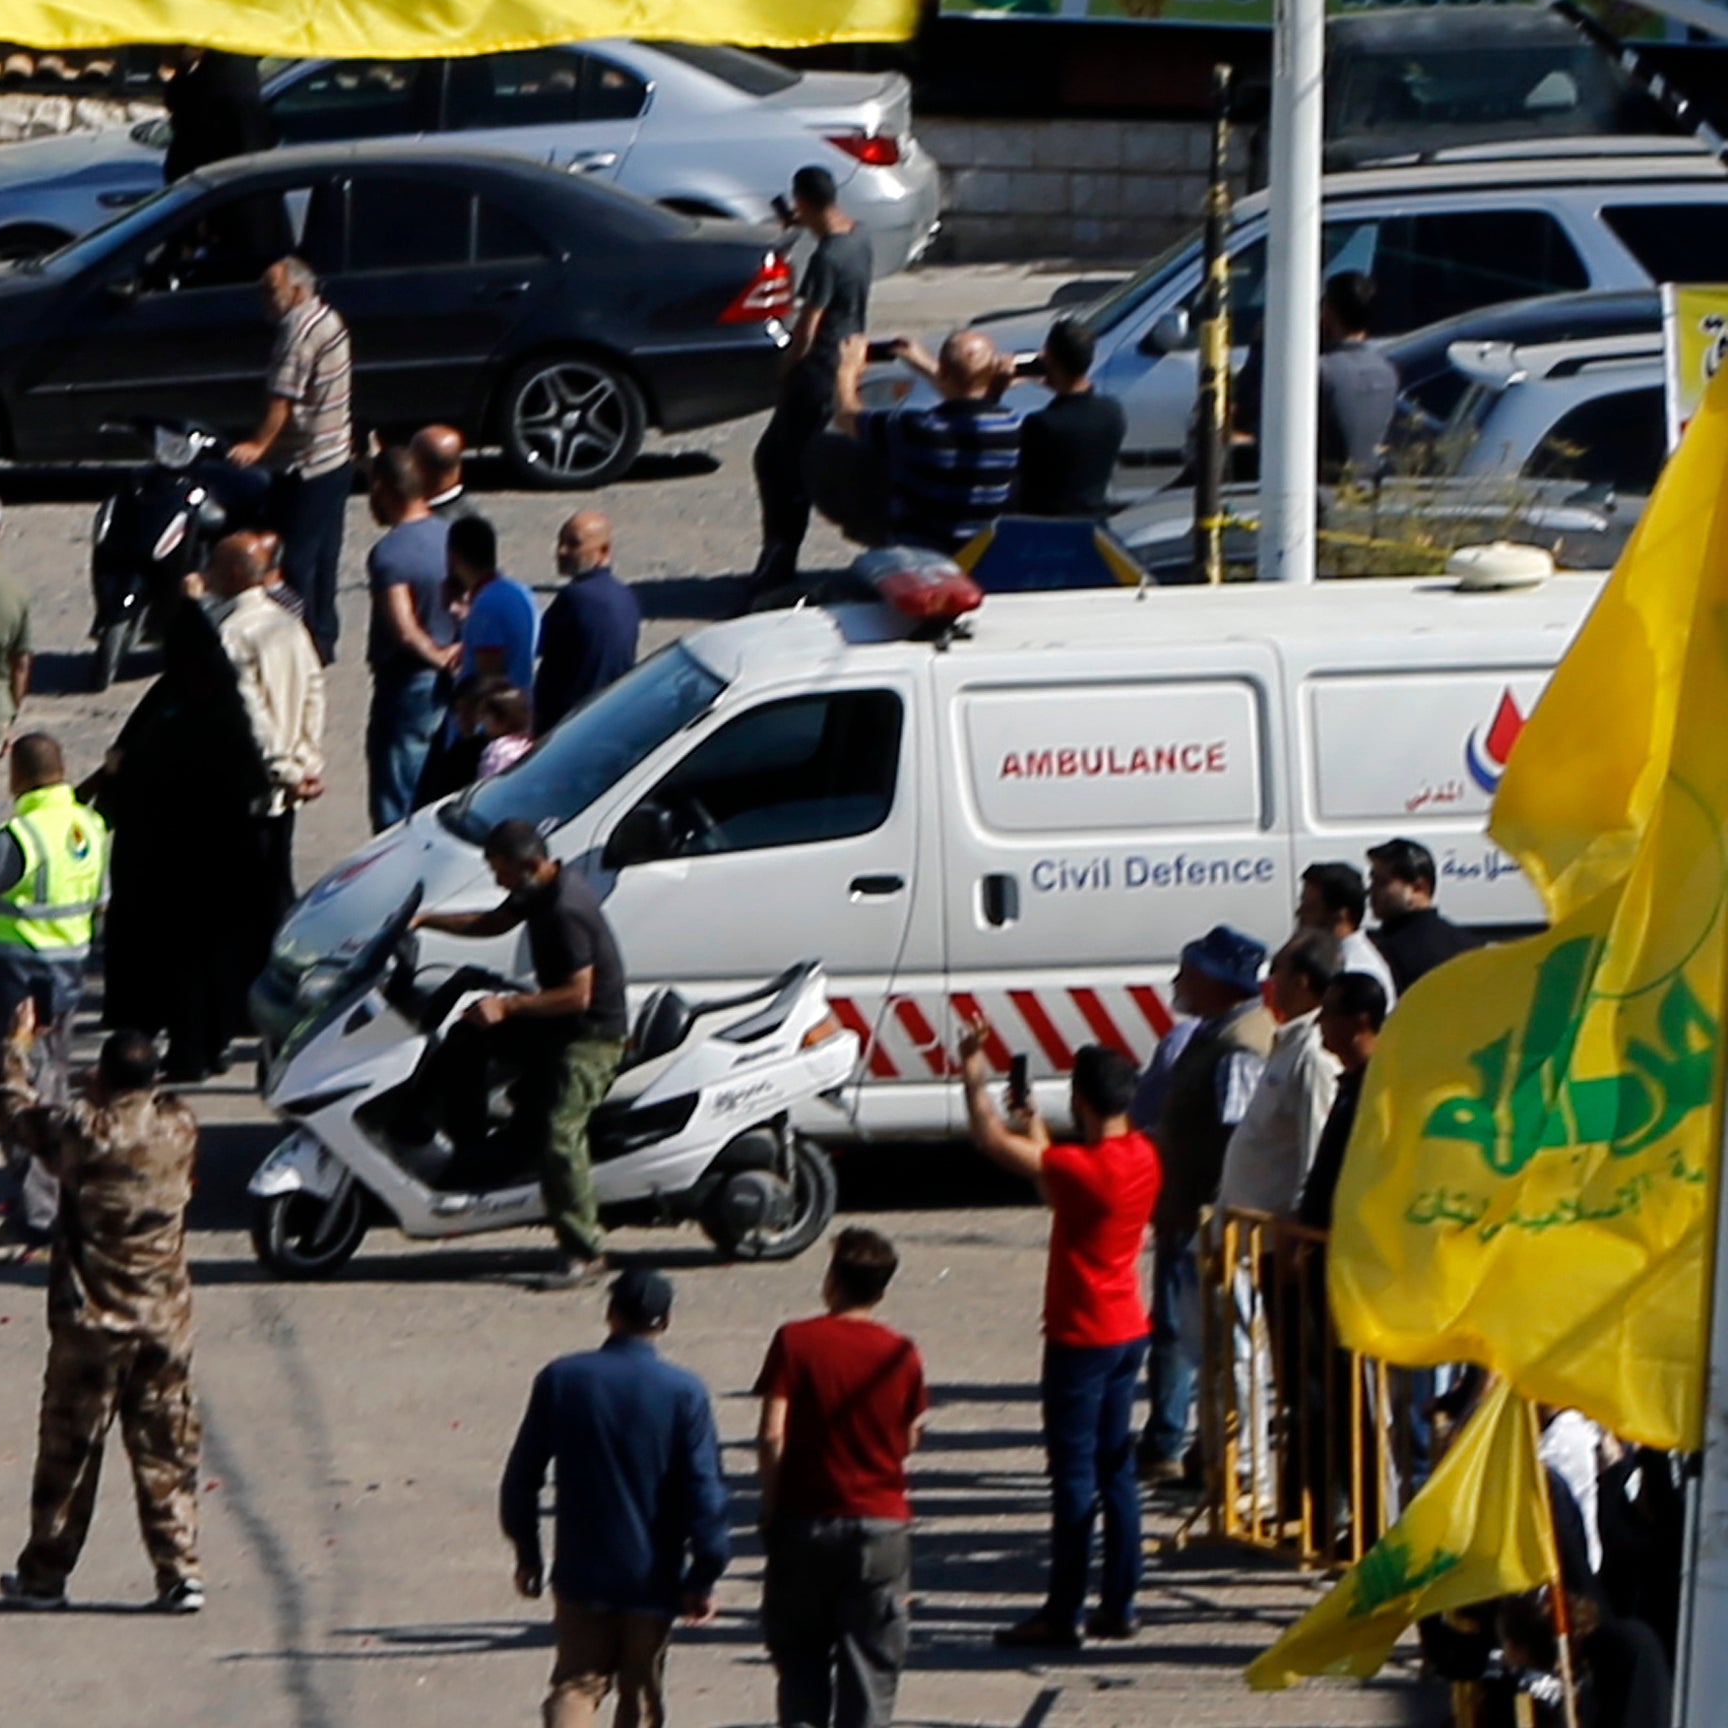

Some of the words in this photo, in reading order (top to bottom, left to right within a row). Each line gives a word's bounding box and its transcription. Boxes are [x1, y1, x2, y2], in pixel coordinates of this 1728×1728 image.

[999, 741, 1227, 780] AMBULANCE
[1030, 855, 1111, 893] Civil
[1125, 854, 1275, 889] Defence
